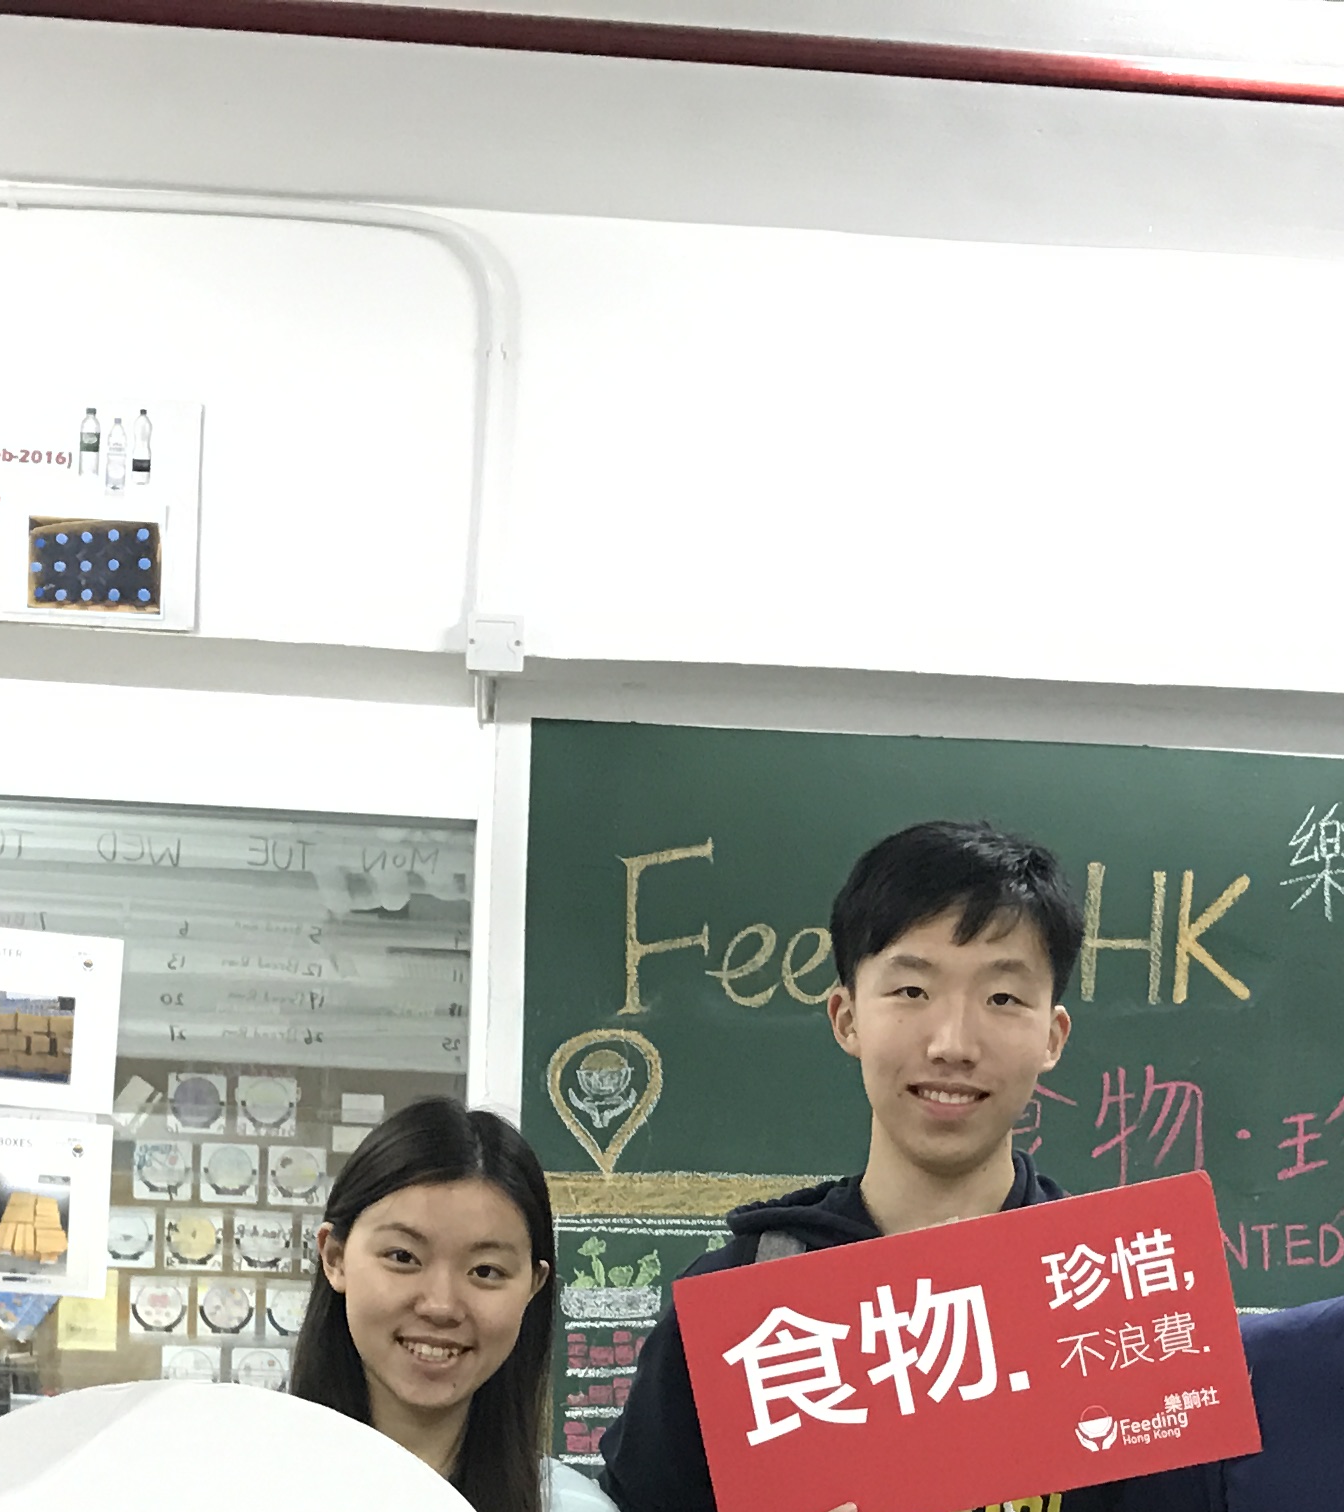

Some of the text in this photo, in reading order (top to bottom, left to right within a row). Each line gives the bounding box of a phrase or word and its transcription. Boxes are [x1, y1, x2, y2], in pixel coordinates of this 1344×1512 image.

[1080, 861, 1252, 1005] HK
[1041, 1227, 1196, 1312] 珍惜,
[722, 1277, 1031, 1447] 食物.
[1057, 1311, 1212, 1378] 不浪費.
[1120, 1410, 1189, 1437] Feeding
[1163, 1385, 1220, 1414] 樂餉社
[1122, 1424, 1182, 1448] Hong Kong
